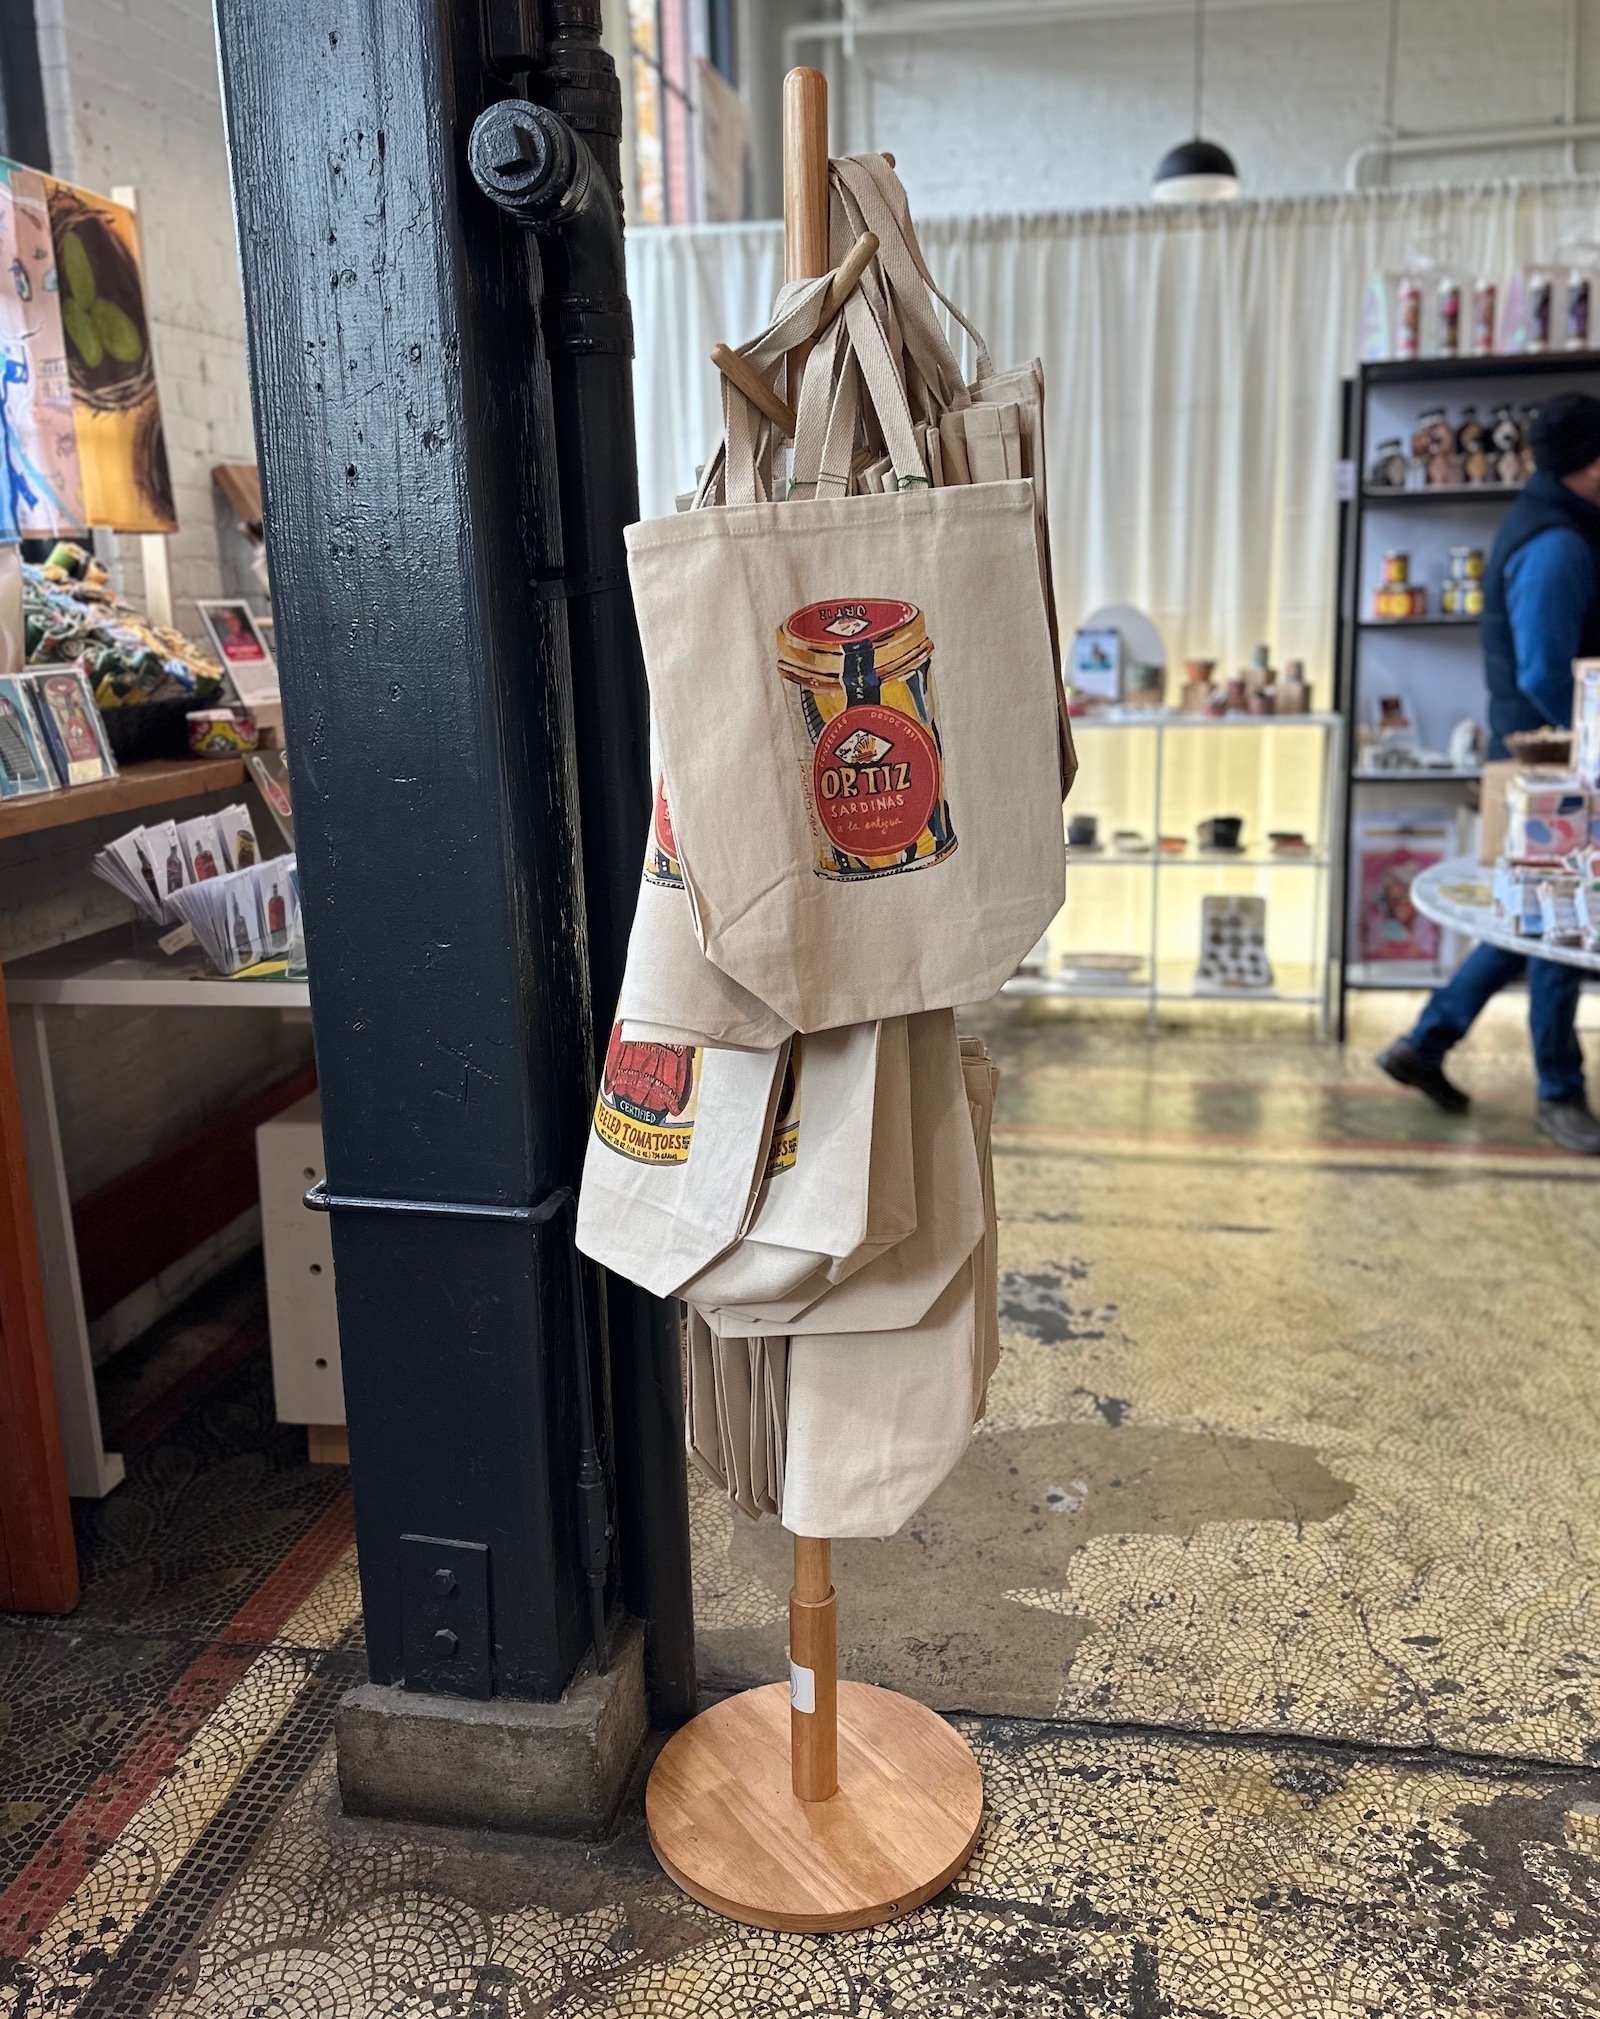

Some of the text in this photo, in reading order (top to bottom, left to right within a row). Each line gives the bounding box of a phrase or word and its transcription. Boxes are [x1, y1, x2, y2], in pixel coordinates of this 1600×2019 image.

[870, 710, 902, 727] DESDE
[819, 717, 848, 768] CONSERVAS
[821, 762, 912, 801] ORTIZ
[831, 794, 905, 818] SARDINAS
[619, 1100, 656, 1123] CERTIFIED
[622, 1123, 682, 1151] TOMATOES
